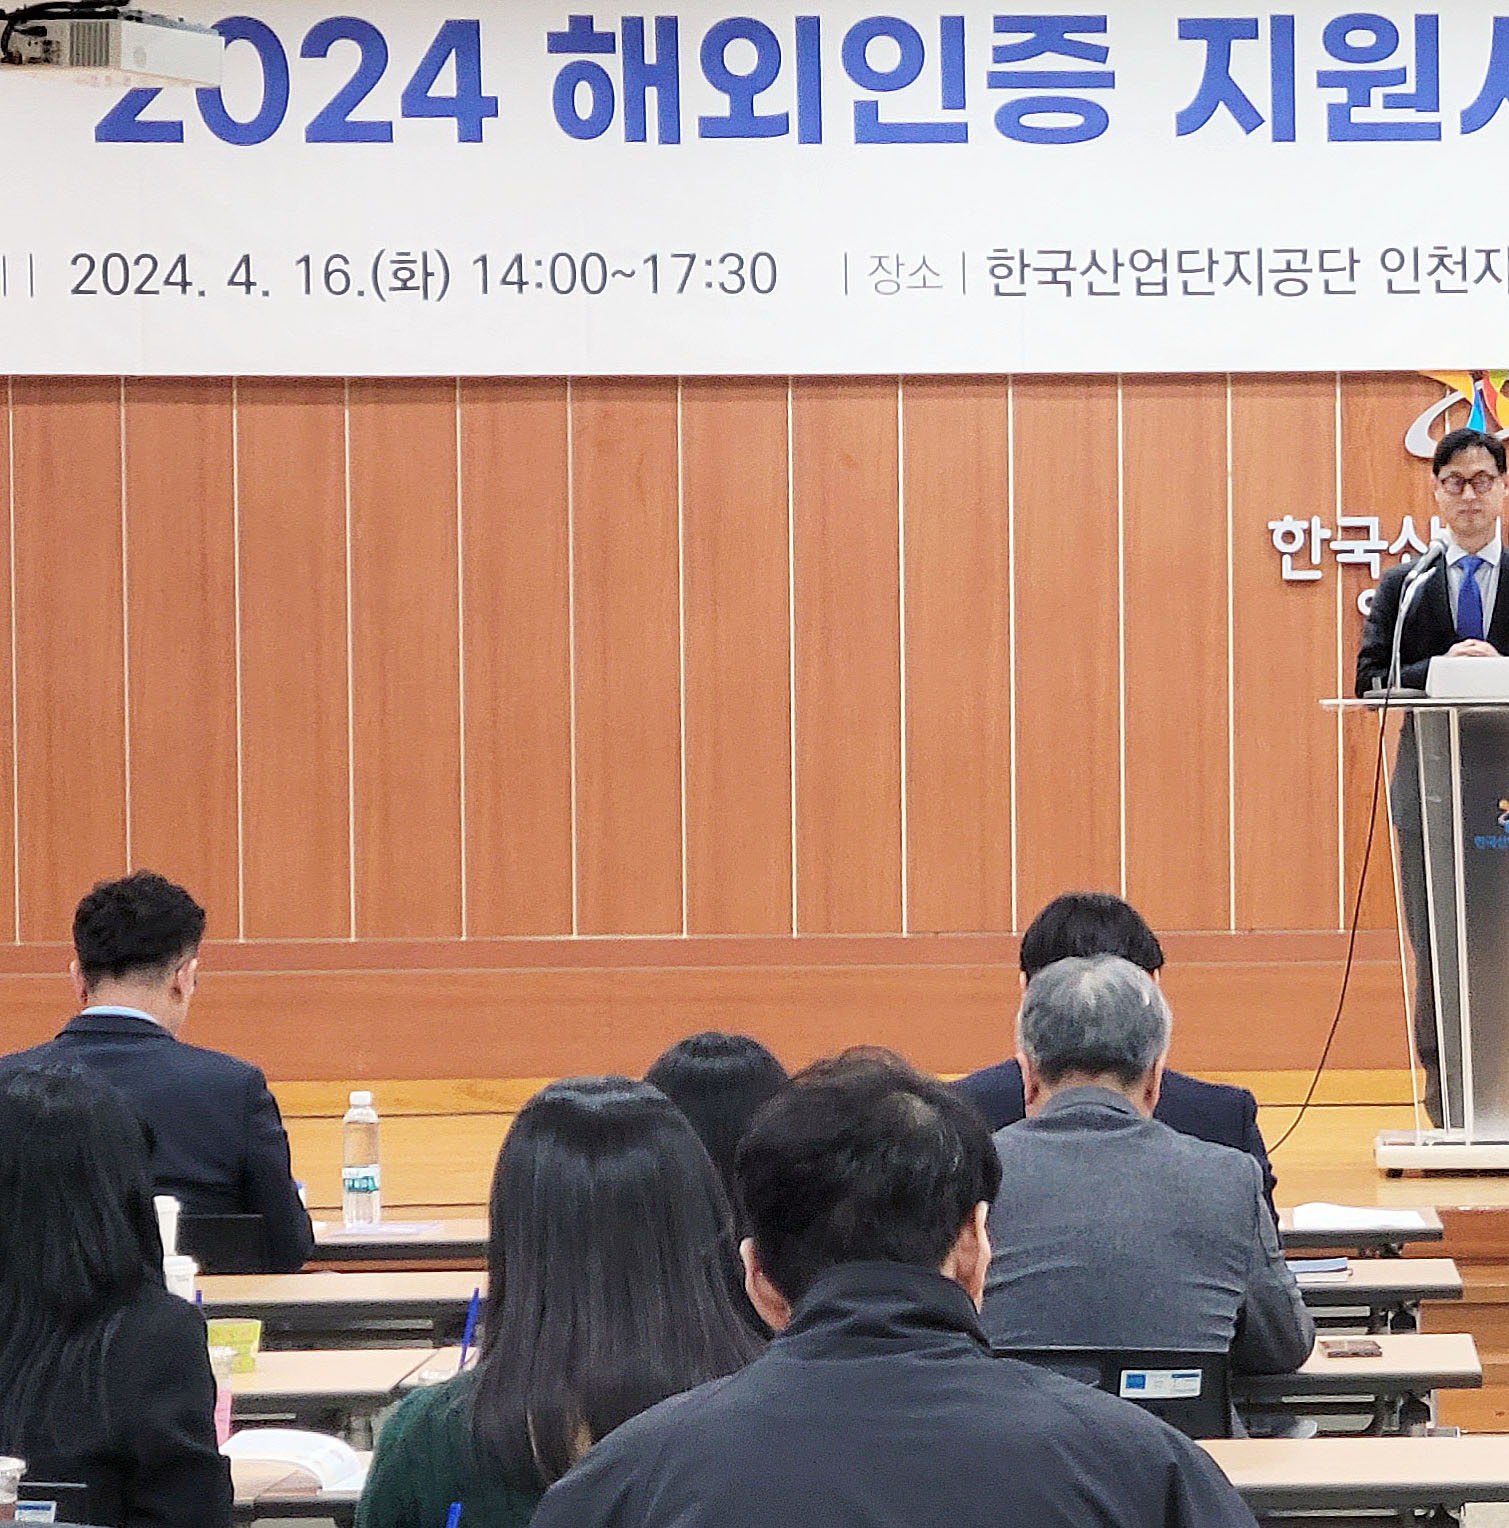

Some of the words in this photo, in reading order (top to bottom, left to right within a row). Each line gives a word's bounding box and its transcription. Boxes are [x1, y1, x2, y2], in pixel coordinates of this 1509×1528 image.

[548, 15, 1116, 145] 해외인증
[70, 252, 207, 299] 2024.
[226, 252, 271, 299] 4.
[294, 247, 451, 304] 16.(화)
[472, 250, 778, 297] 14:00~17:30
[867, 252, 945, 297] 장소
[986, 246, 1361, 299] 한국산업단지공단
